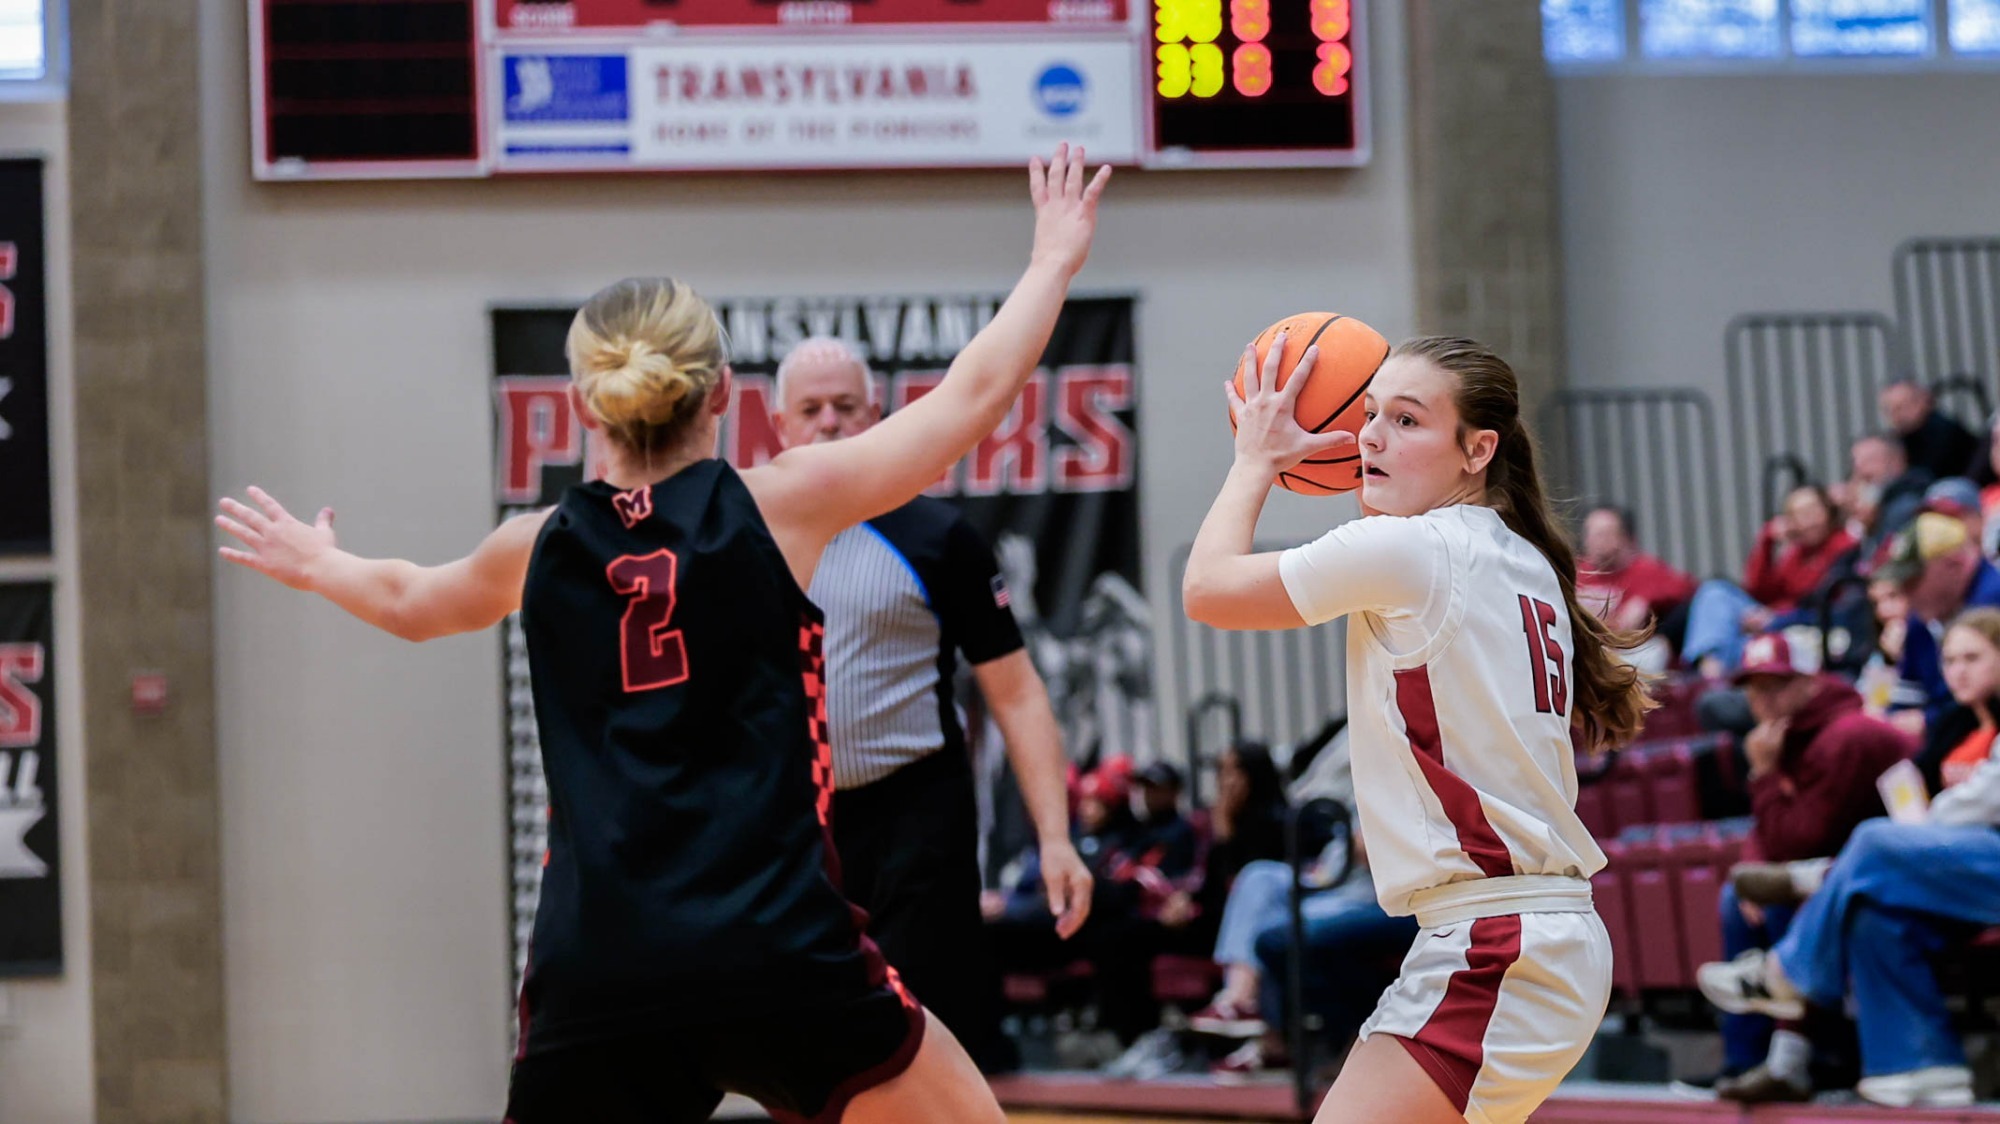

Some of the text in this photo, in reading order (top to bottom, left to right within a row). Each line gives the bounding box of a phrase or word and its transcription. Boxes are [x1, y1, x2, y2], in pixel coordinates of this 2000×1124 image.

[654, 64, 978, 102] TRANSYLVANIA
[612, 484, 652, 529] M
[606, 548, 689, 692] 2
[1518, 594, 1567, 717] 15
